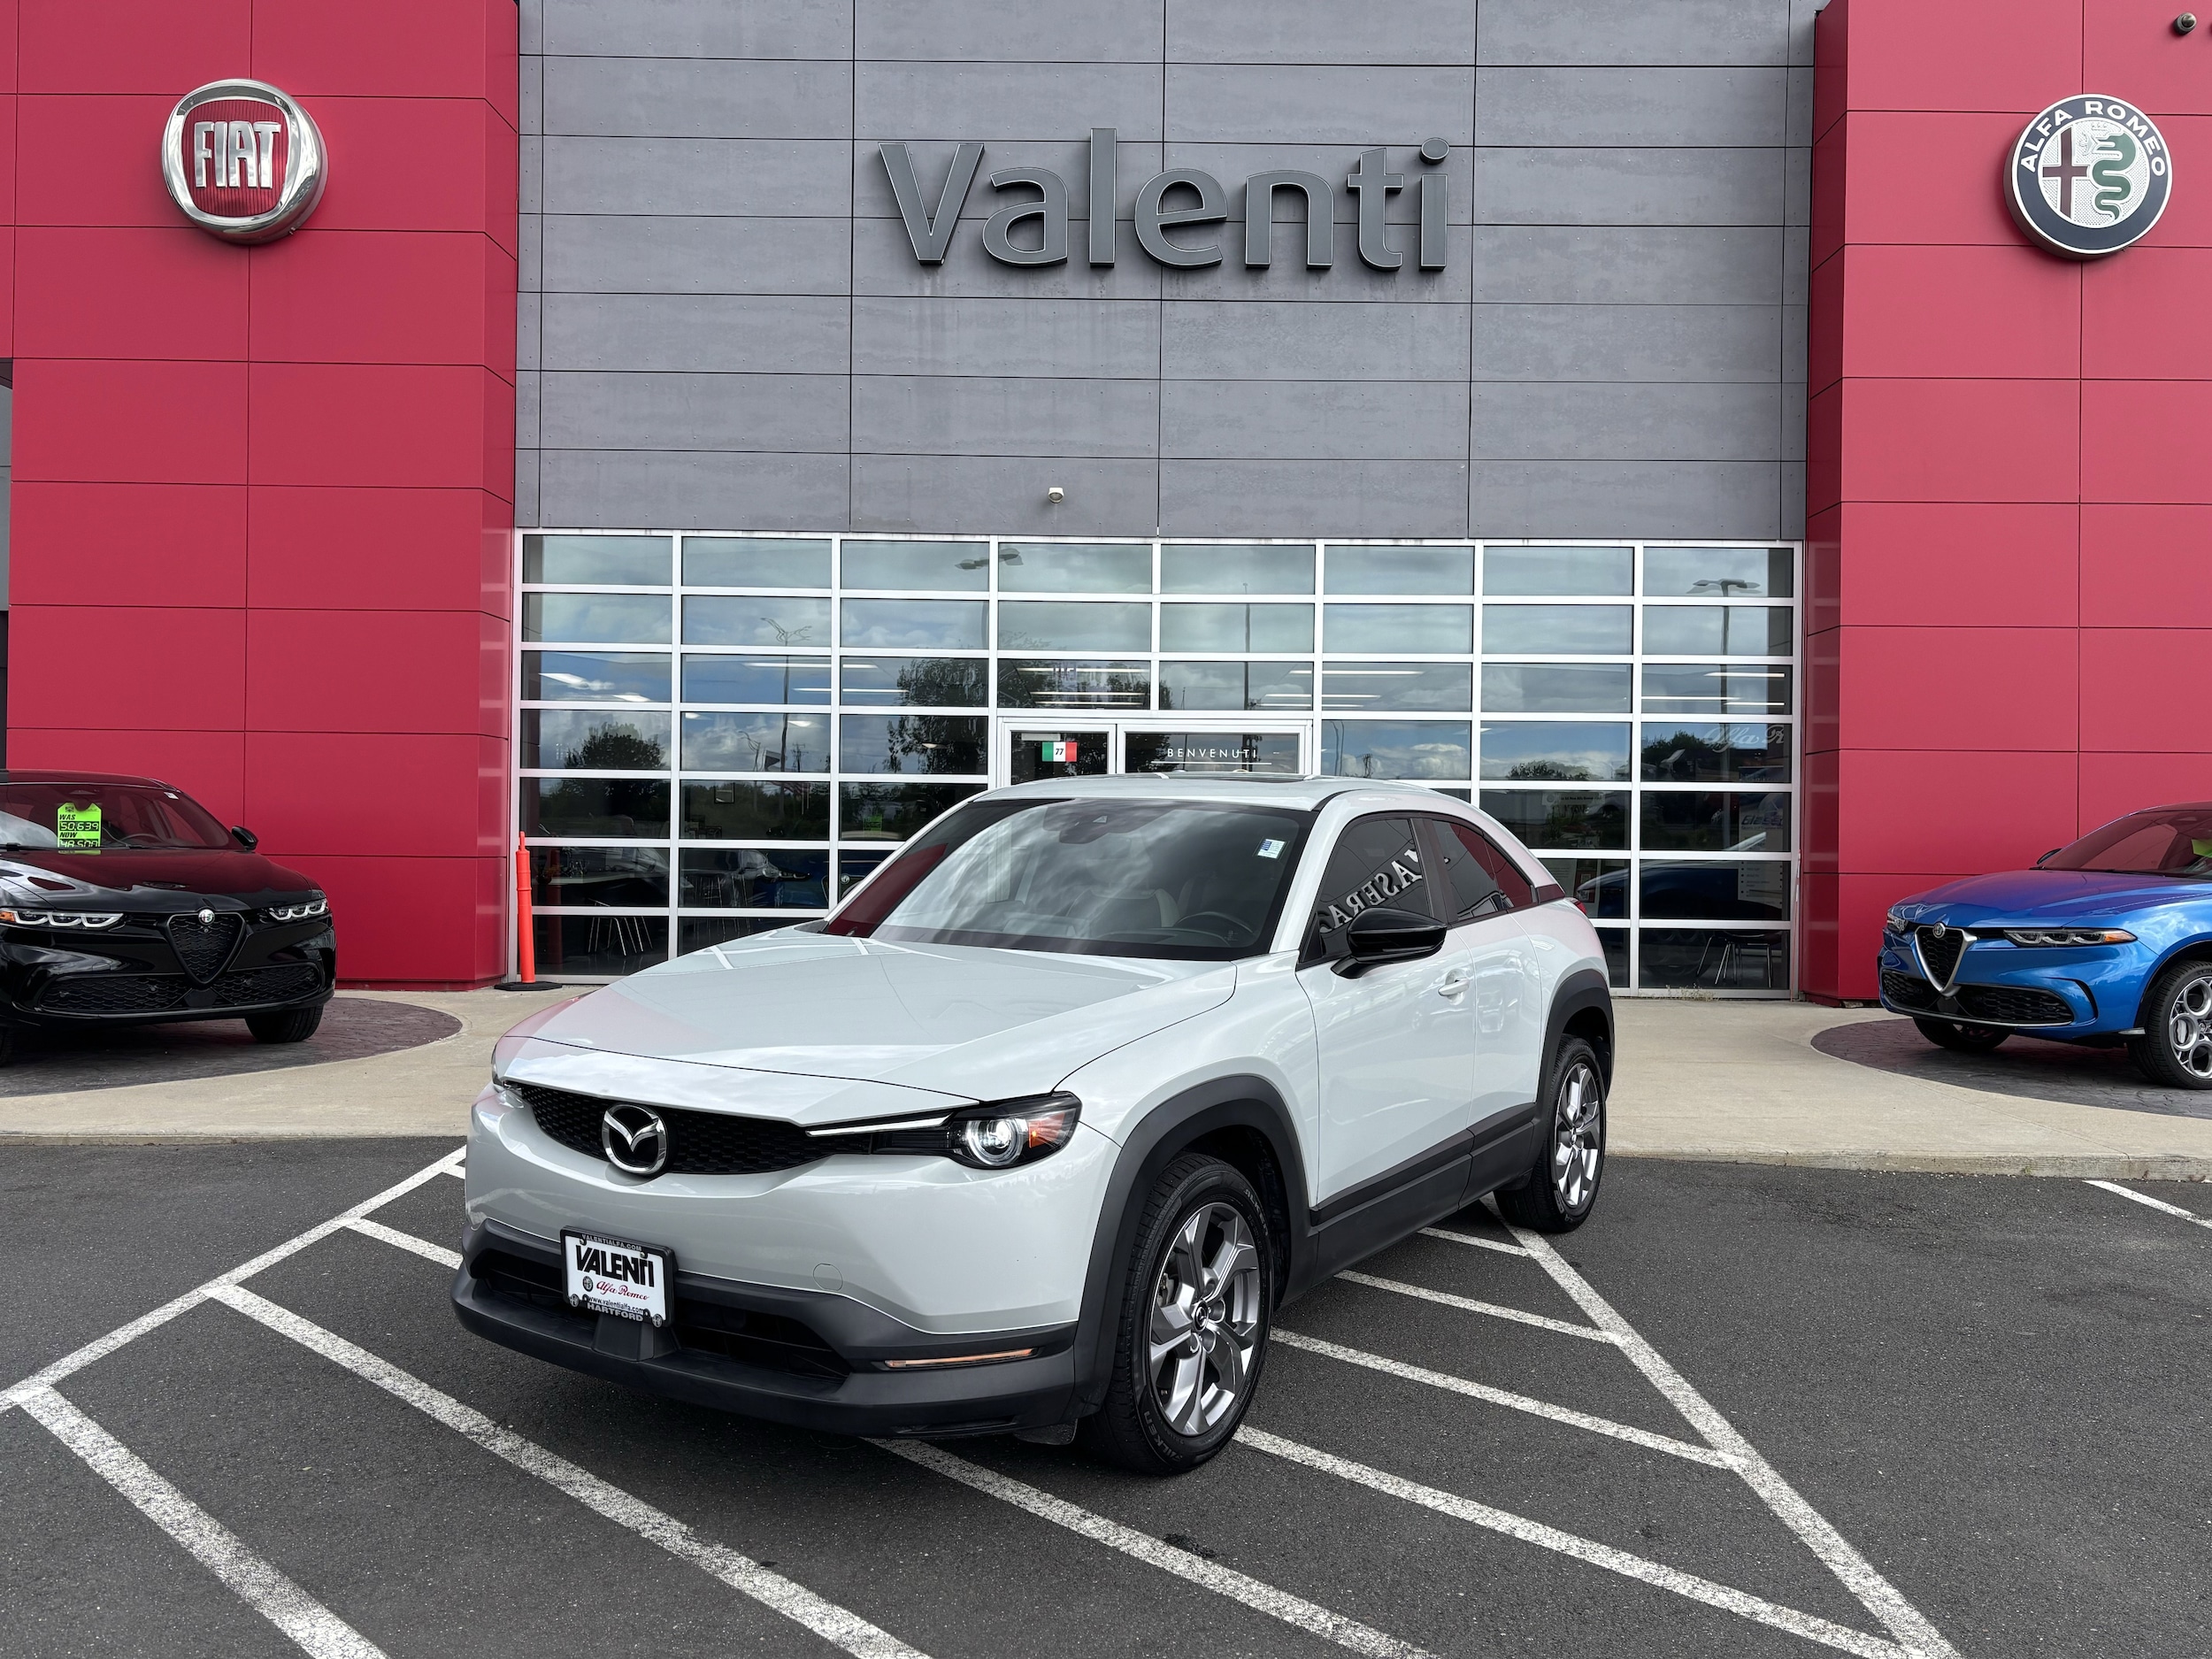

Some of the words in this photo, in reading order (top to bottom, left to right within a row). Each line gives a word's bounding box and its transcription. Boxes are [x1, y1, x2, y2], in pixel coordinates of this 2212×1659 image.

[2020, 109, 2073, 173] ALFA
[2085, 100, 2166, 177] ROMEO
[193, 120, 281, 189] FIAT
[877, 127, 1449, 271] Valenti
[1167, 748, 1256, 758] BENVENUTI
[60, 822, 99, 831] 50,639
[581, 1233, 643, 1252] VALENTIALFA.COM
[575, 1244, 655, 1287] VALENTI
[595, 1280, 618, 1295] Alfa
[618, 1285, 650, 1301] Romeo
[587, 1302, 644, 1322] HARTFORD
